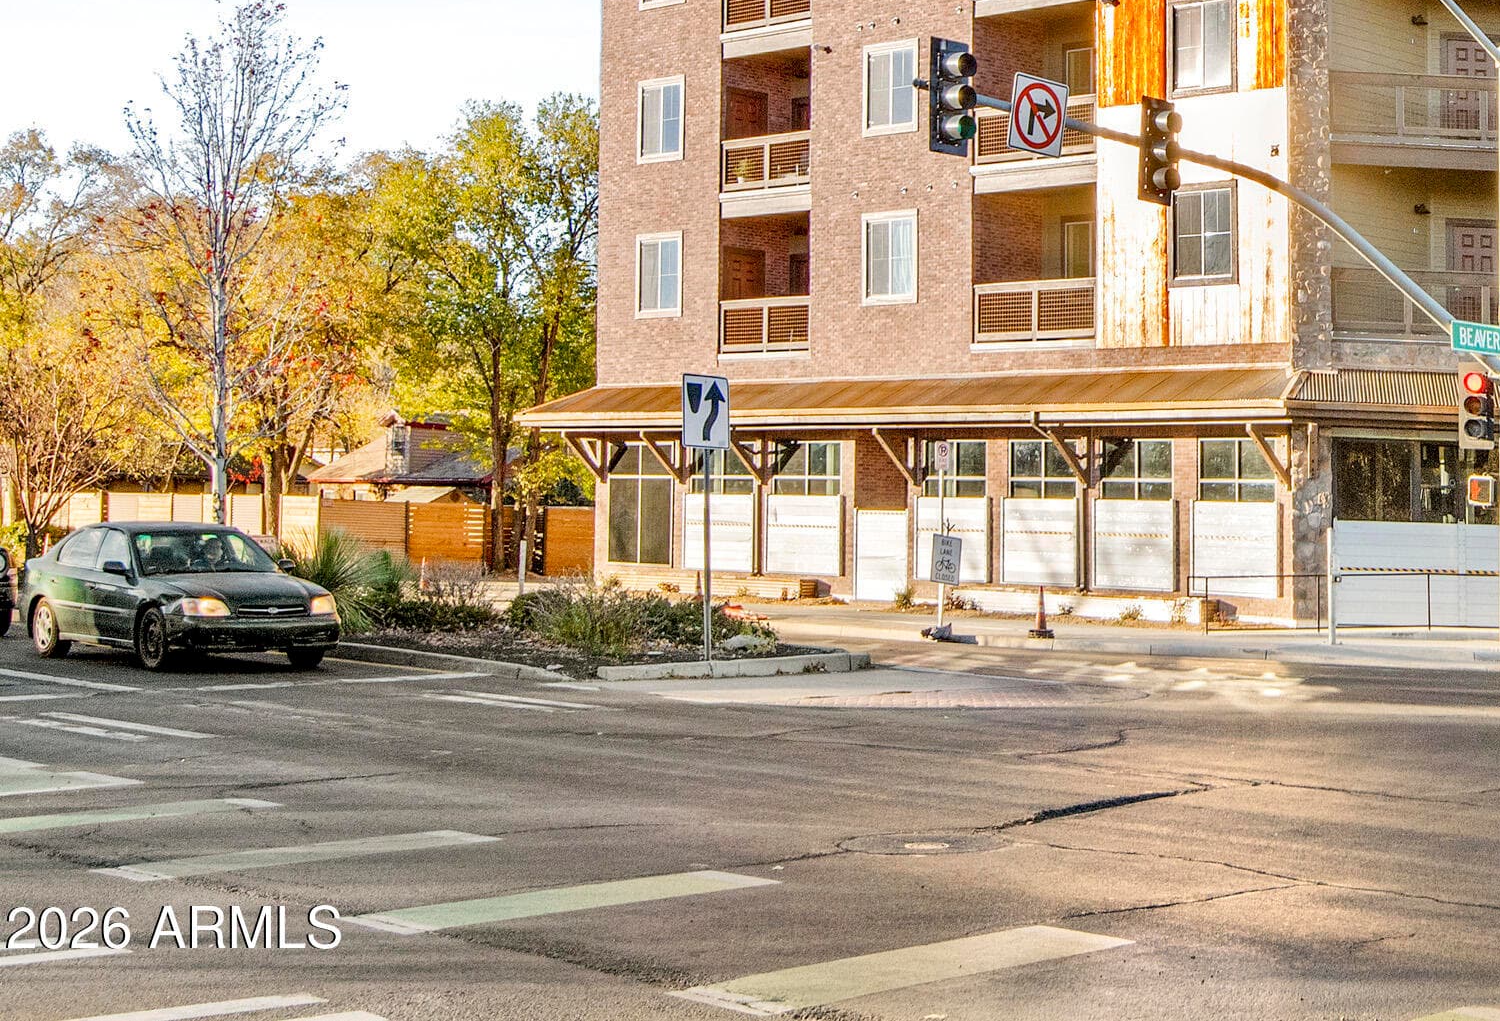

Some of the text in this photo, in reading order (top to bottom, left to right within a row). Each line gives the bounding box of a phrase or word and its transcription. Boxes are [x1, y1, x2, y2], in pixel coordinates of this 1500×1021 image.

[1459, 327, 1500, 351] BEAVER
[941, 538, 953, 547] BIKE
[940, 548, 953, 556] LANE
[935, 572, 955, 582] CLOSED
